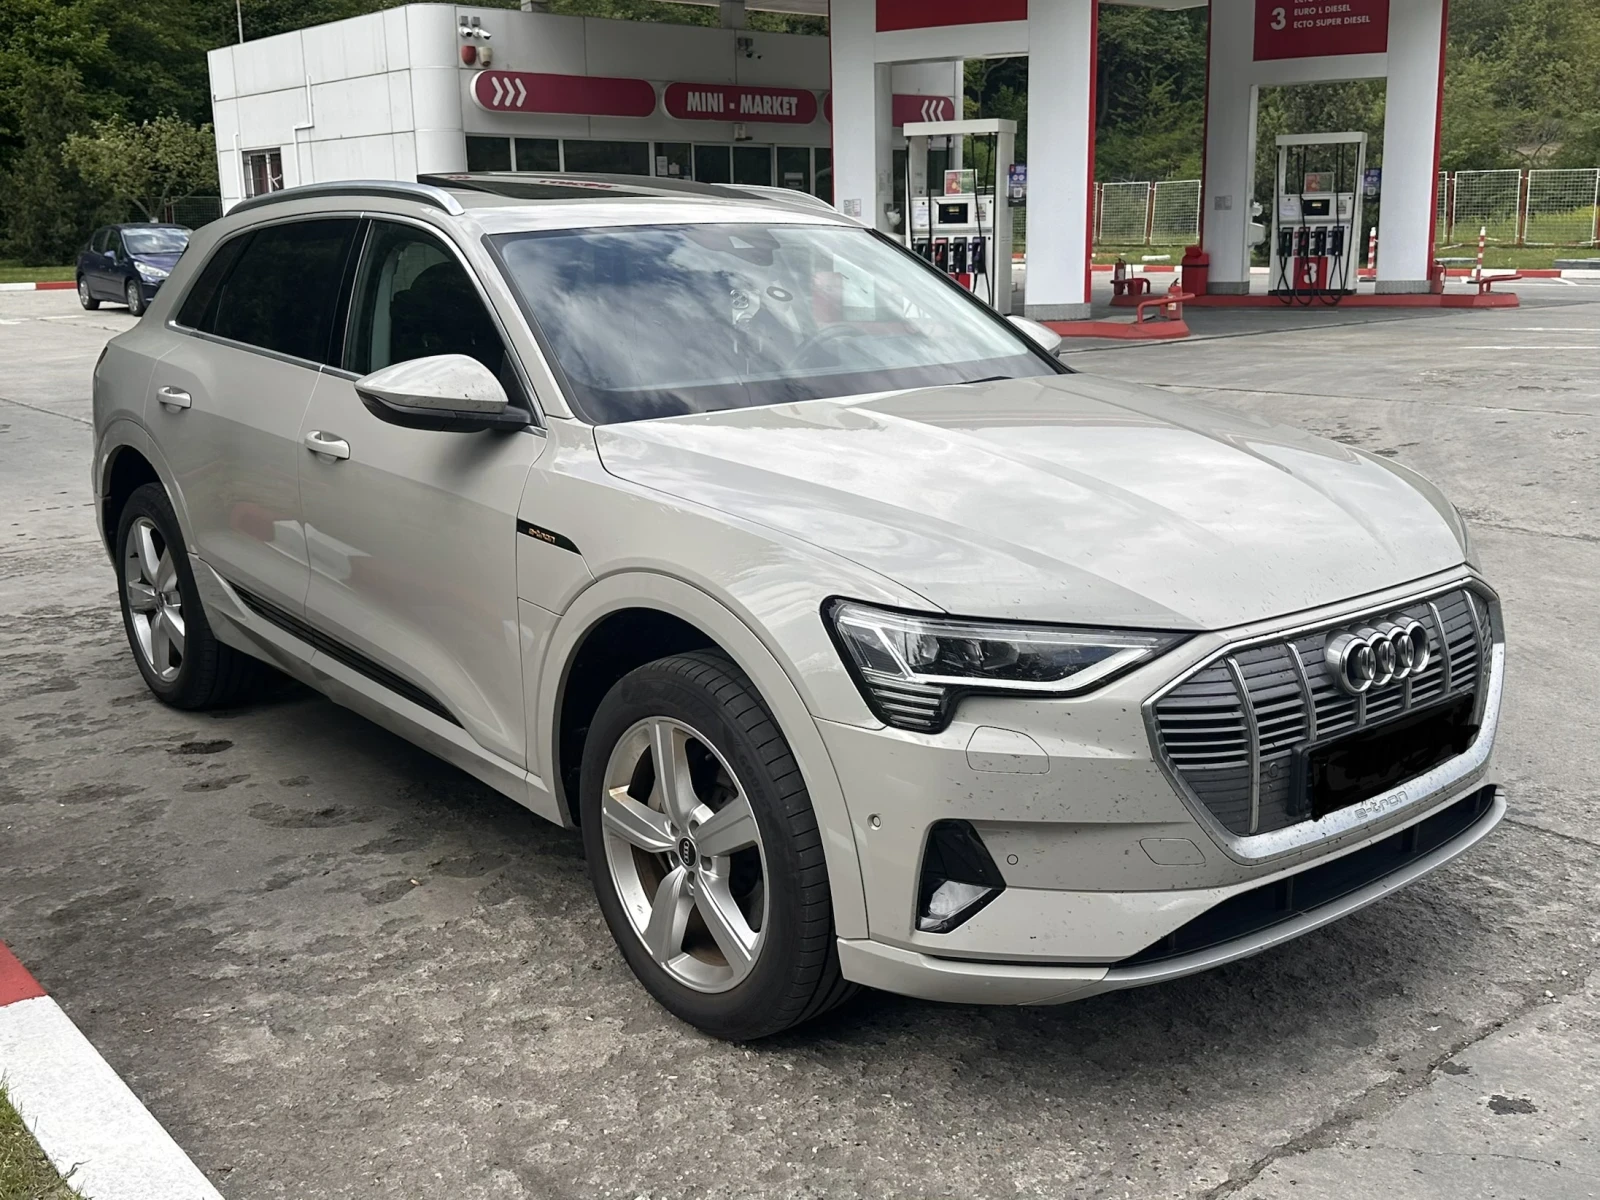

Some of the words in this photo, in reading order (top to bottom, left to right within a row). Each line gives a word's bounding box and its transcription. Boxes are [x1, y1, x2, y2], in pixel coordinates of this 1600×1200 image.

[1270, 7, 1287, 30] 3
[1294, 7, 1316, 16] EURO
[1318, 6, 1323, 14] L
[1325, 4, 1351, 13] DIESEL
[1293, 20, 1314, 29] ECTO
[1316, 17, 1342, 27] SUPER
[1344, 15, 1371, 25] DIESEL
[687, 91, 724, 113] MINI
[740, 94, 798, 116] MARKET
[1303, 262, 1317, 284] 3
[1354, 790, 1408, 819] e-tron
